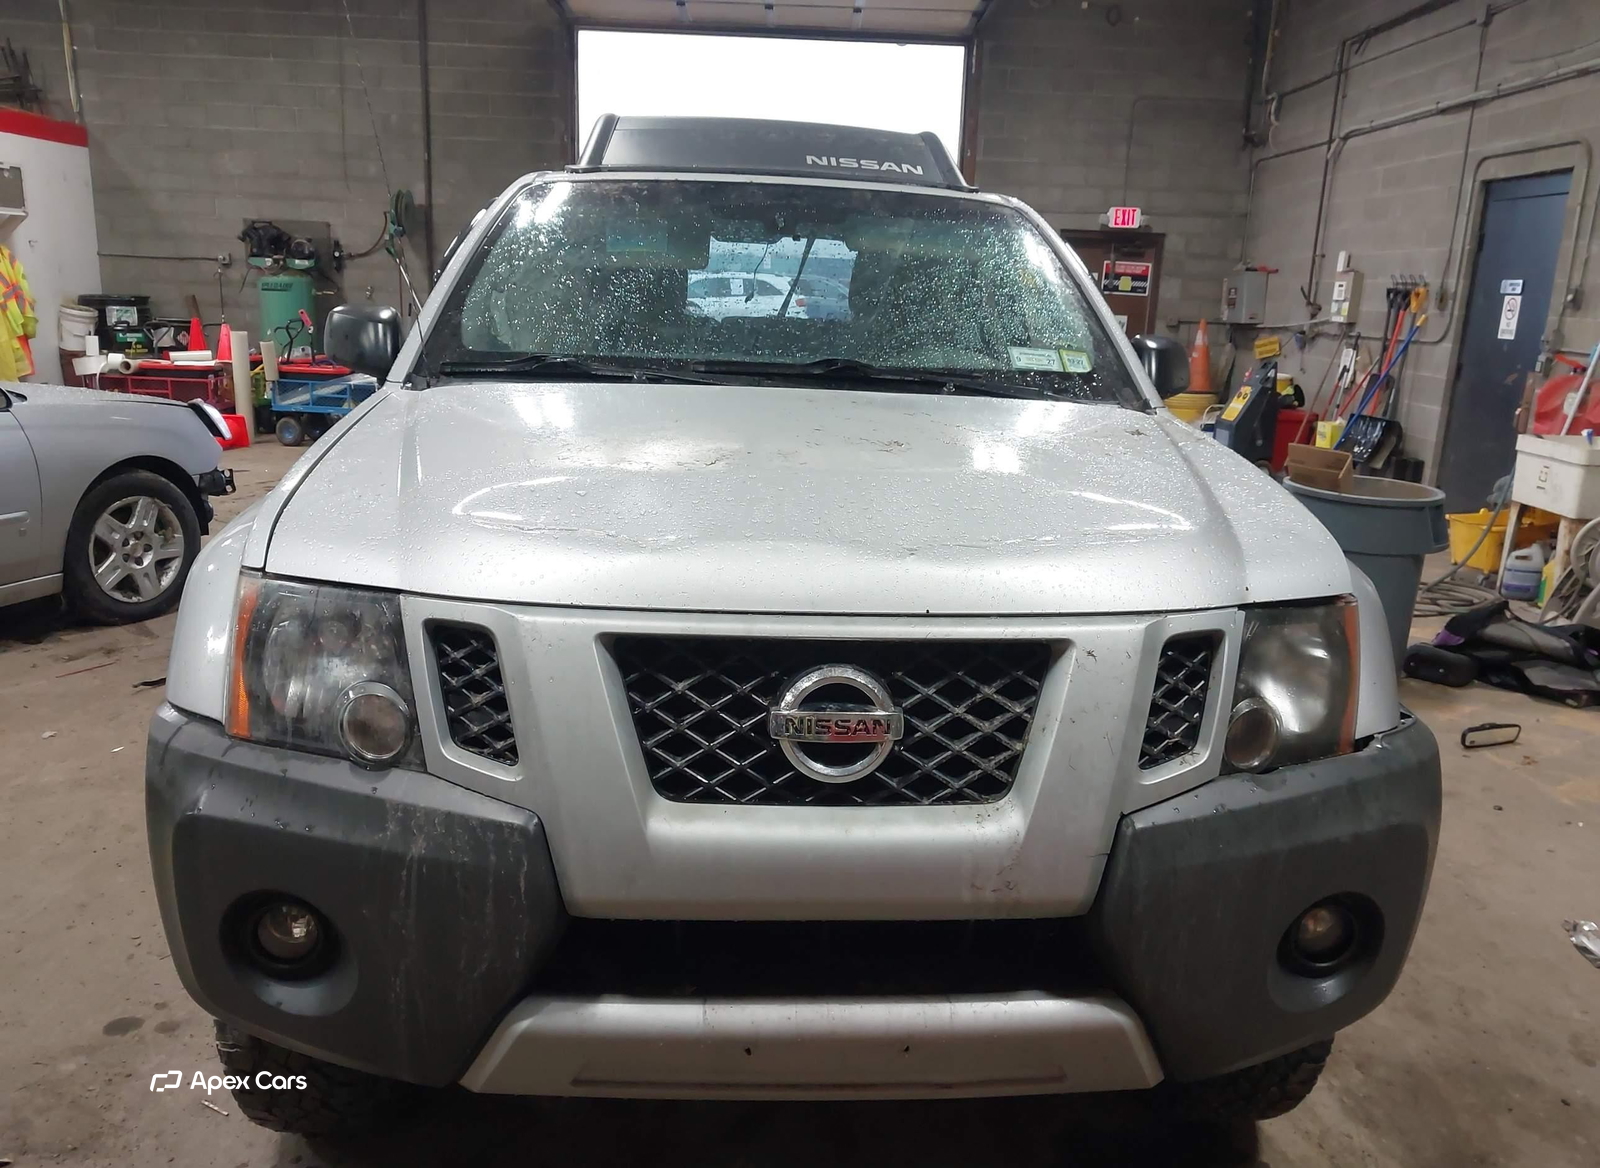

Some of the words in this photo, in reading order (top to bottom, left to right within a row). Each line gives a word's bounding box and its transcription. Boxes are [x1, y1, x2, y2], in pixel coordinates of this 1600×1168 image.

[805, 155, 924, 175] NISSAN
[1113, 208, 1137, 226] EXIT
[784, 717, 891, 737] NISSAN
